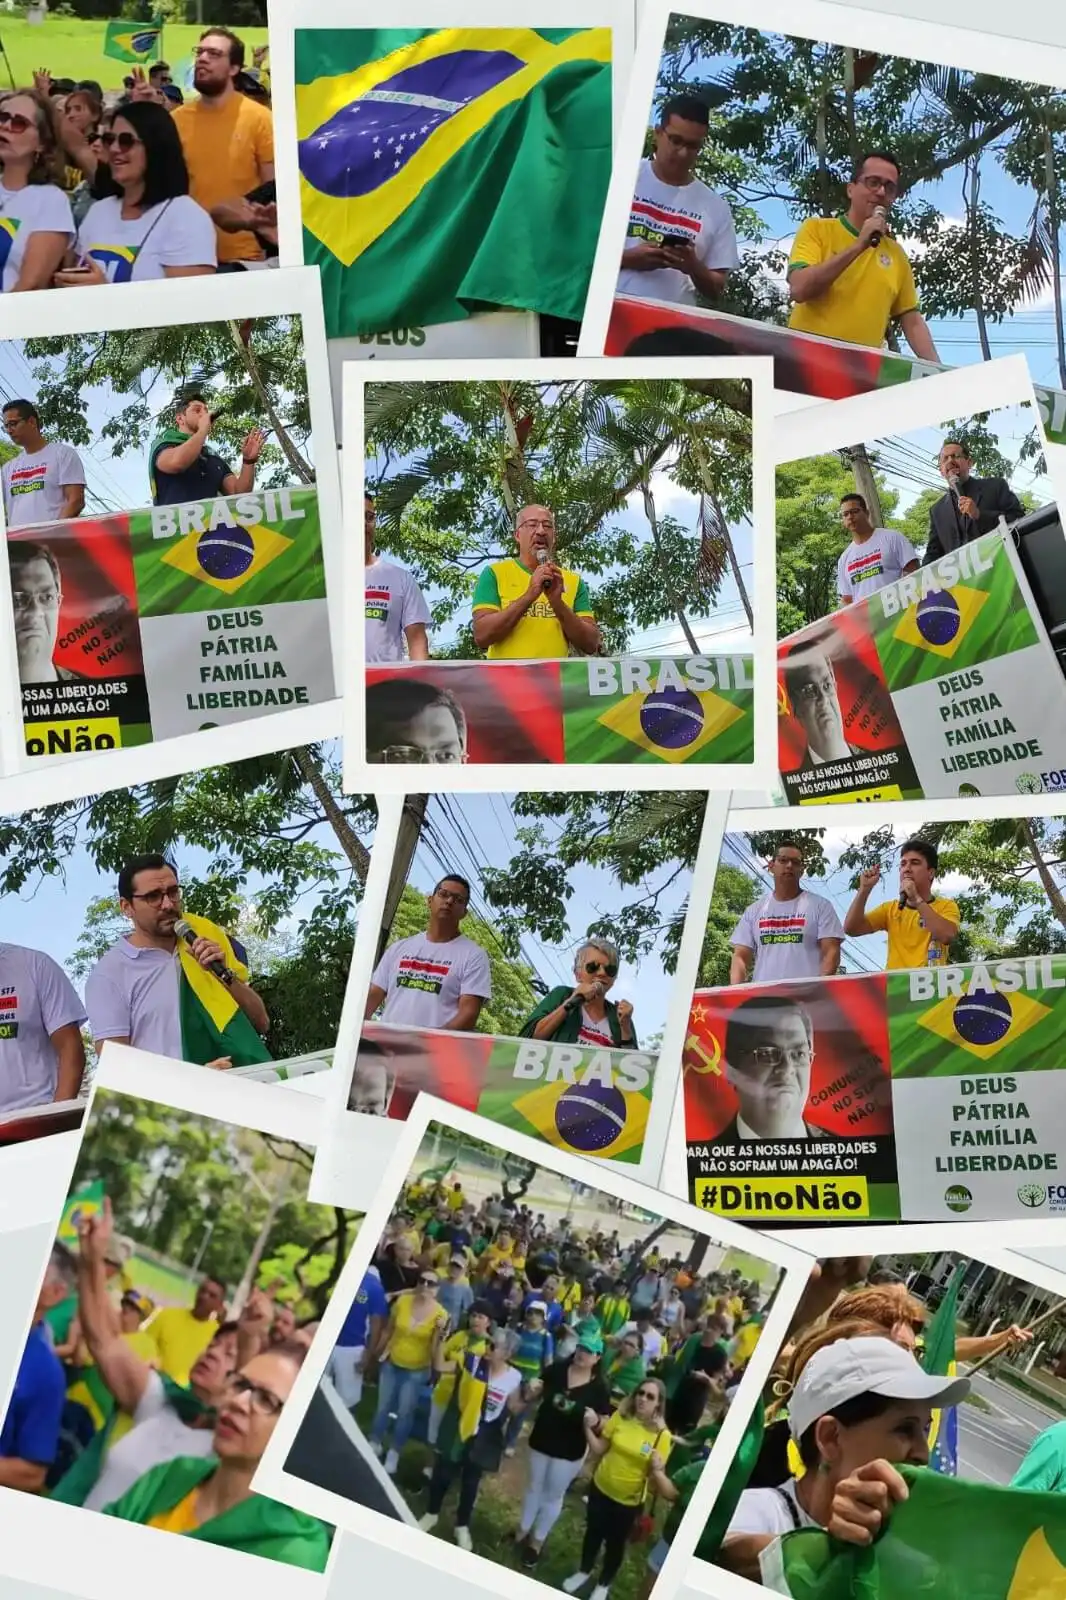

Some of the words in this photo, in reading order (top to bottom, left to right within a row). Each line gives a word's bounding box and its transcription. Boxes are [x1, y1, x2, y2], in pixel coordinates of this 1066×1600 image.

[150, 489, 306, 540] BRASIL
[880, 543, 994, 619] BRASIL
[206, 609, 264, 631] DEUS
[82, 636, 101, 655] NO
[201, 635, 279, 657] PÁTRIA
[200, 659, 287, 683] FAMÍLIA
[586, 656, 754, 696] BRASIL
[937, 669, 984, 696] DEUS
[56, 682, 129, 700] LIBERDADES
[186, 686, 310, 711] LIBERDADE
[32, 704, 51, 716] UM
[54, 698, 110, 715] APAGÃO!
[939, 692, 1003, 722] PÁTRIA
[26, 725, 116, 757] oNão
[944, 717, 1017, 747] FAMÍLIA
[801, 770, 816, 782] QUE
[816, 768, 825, 779] AS
[825, 762, 853, 778] NOSSAS
[852, 753, 899, 771] LIBERDADES
[941, 738, 1043, 773] LIBERDADE
[798, 782, 814, 796] NÃO
[814, 777, 843, 793] SOFRAM
[842, 774, 856, 788] UM
[854, 768, 891, 786] APAGÃO!
[909, 956, 1066, 1002] BRASIL
[513, 1044, 651, 1092] BRAS
[960, 1077, 1018, 1096] DEUS
[832, 1095, 852, 1113] NO
[952, 1100, 1031, 1122] PÁTRIA
[950, 1124, 1039, 1147] FAMÍLIA
[711, 1145, 736, 1158] QUE
[738, 1144, 753, 1156] AS
[755, 1143, 802, 1156] NOSSAS
[805, 1141, 877, 1156] LIBERDADES
[699, 1158, 727, 1172] NÃO
[729, 1158, 778, 1172] SOFRAM
[779, 1159, 799, 1171] UM
[800, 1155, 859, 1171] APAGÃO!
[935, 1153, 1059, 1173] LIBERDADE
[701, 1182, 863, 1211] #DinoNão
